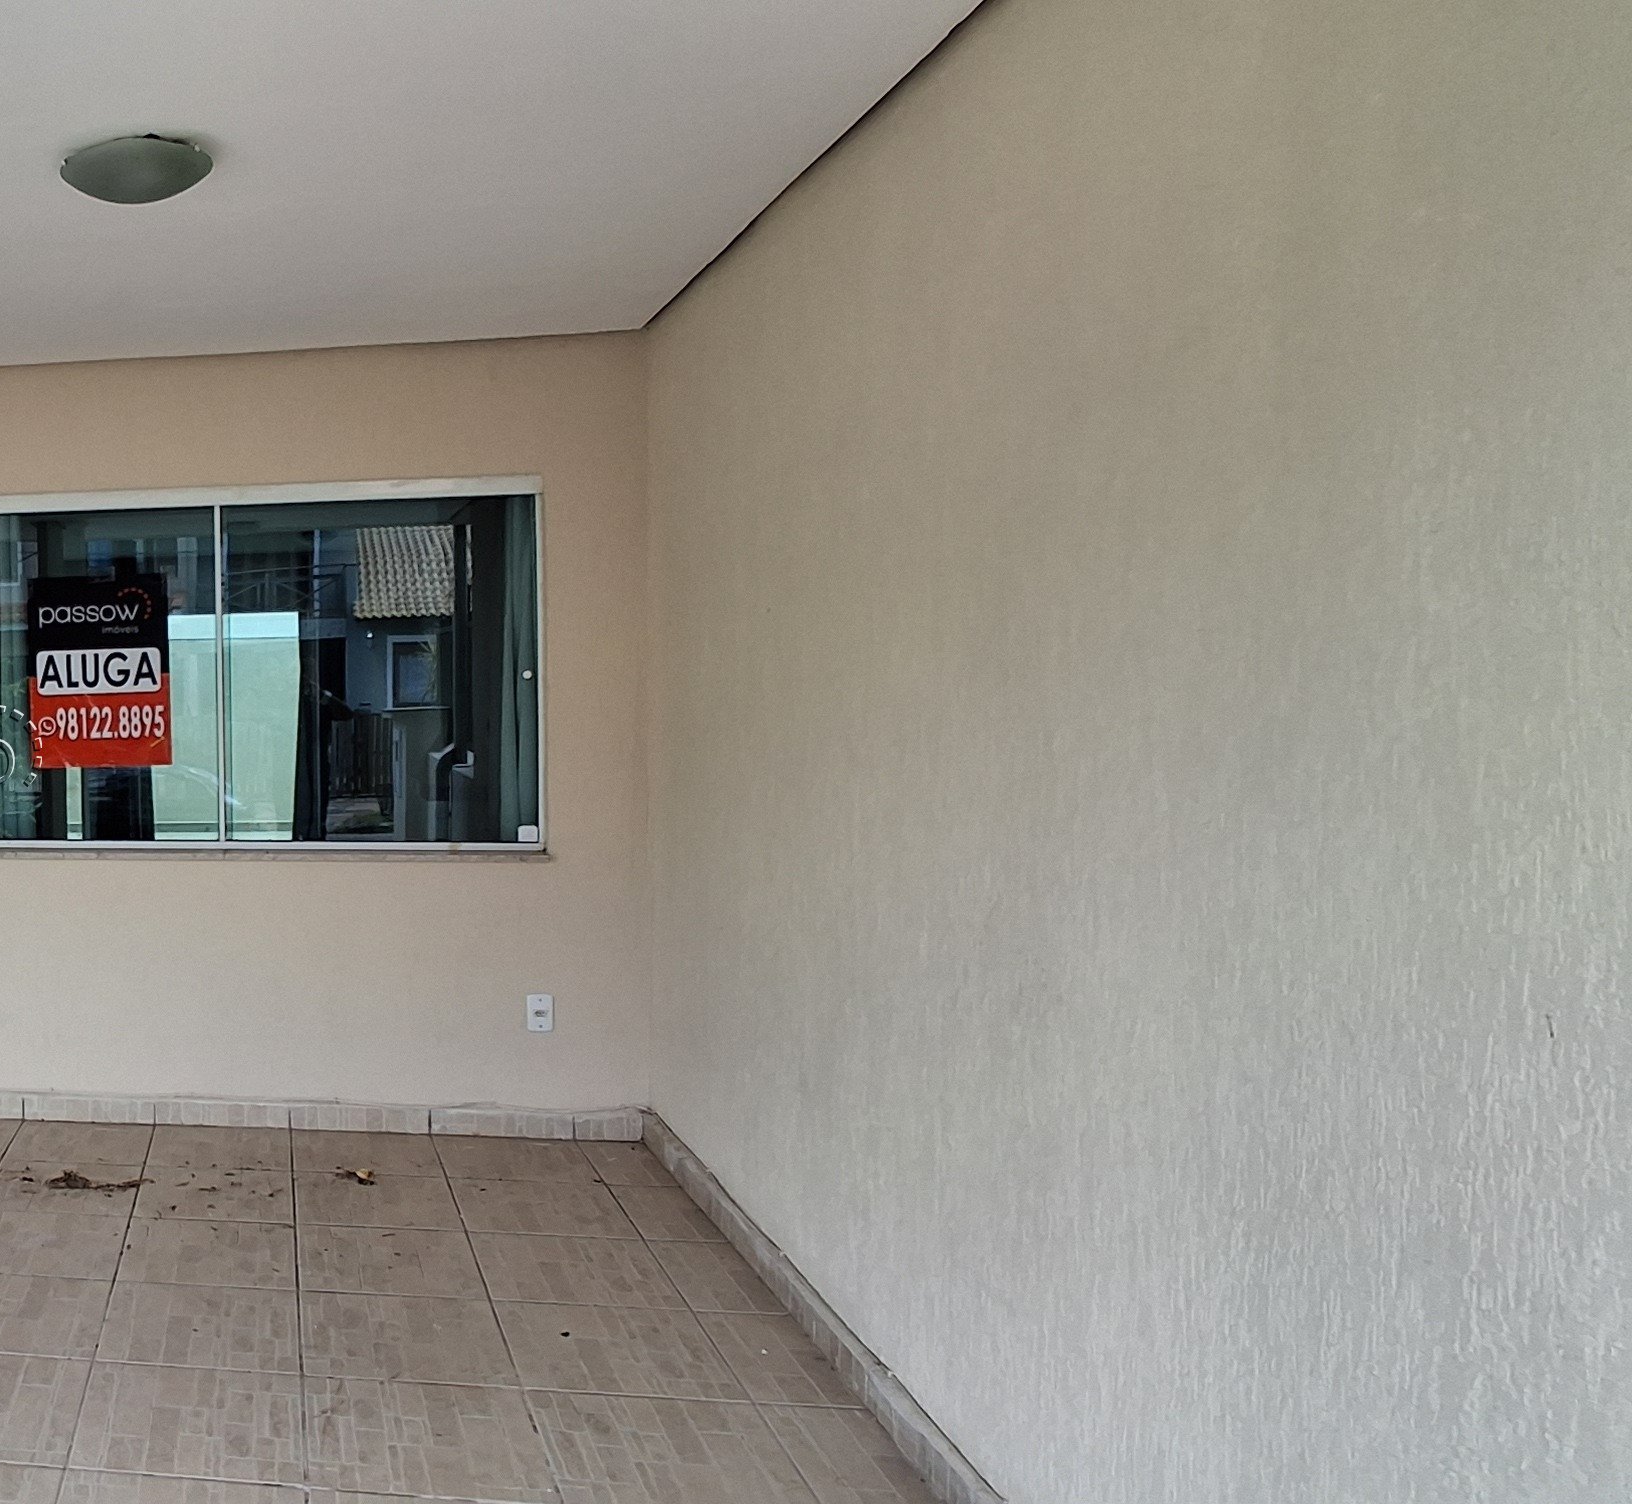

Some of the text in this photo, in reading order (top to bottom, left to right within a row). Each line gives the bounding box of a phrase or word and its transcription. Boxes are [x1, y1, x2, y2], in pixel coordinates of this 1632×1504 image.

[38, 604, 139, 628] passow
[39, 652, 158, 689] ALUGA
[56, 705, 165, 740] 98122.8895
